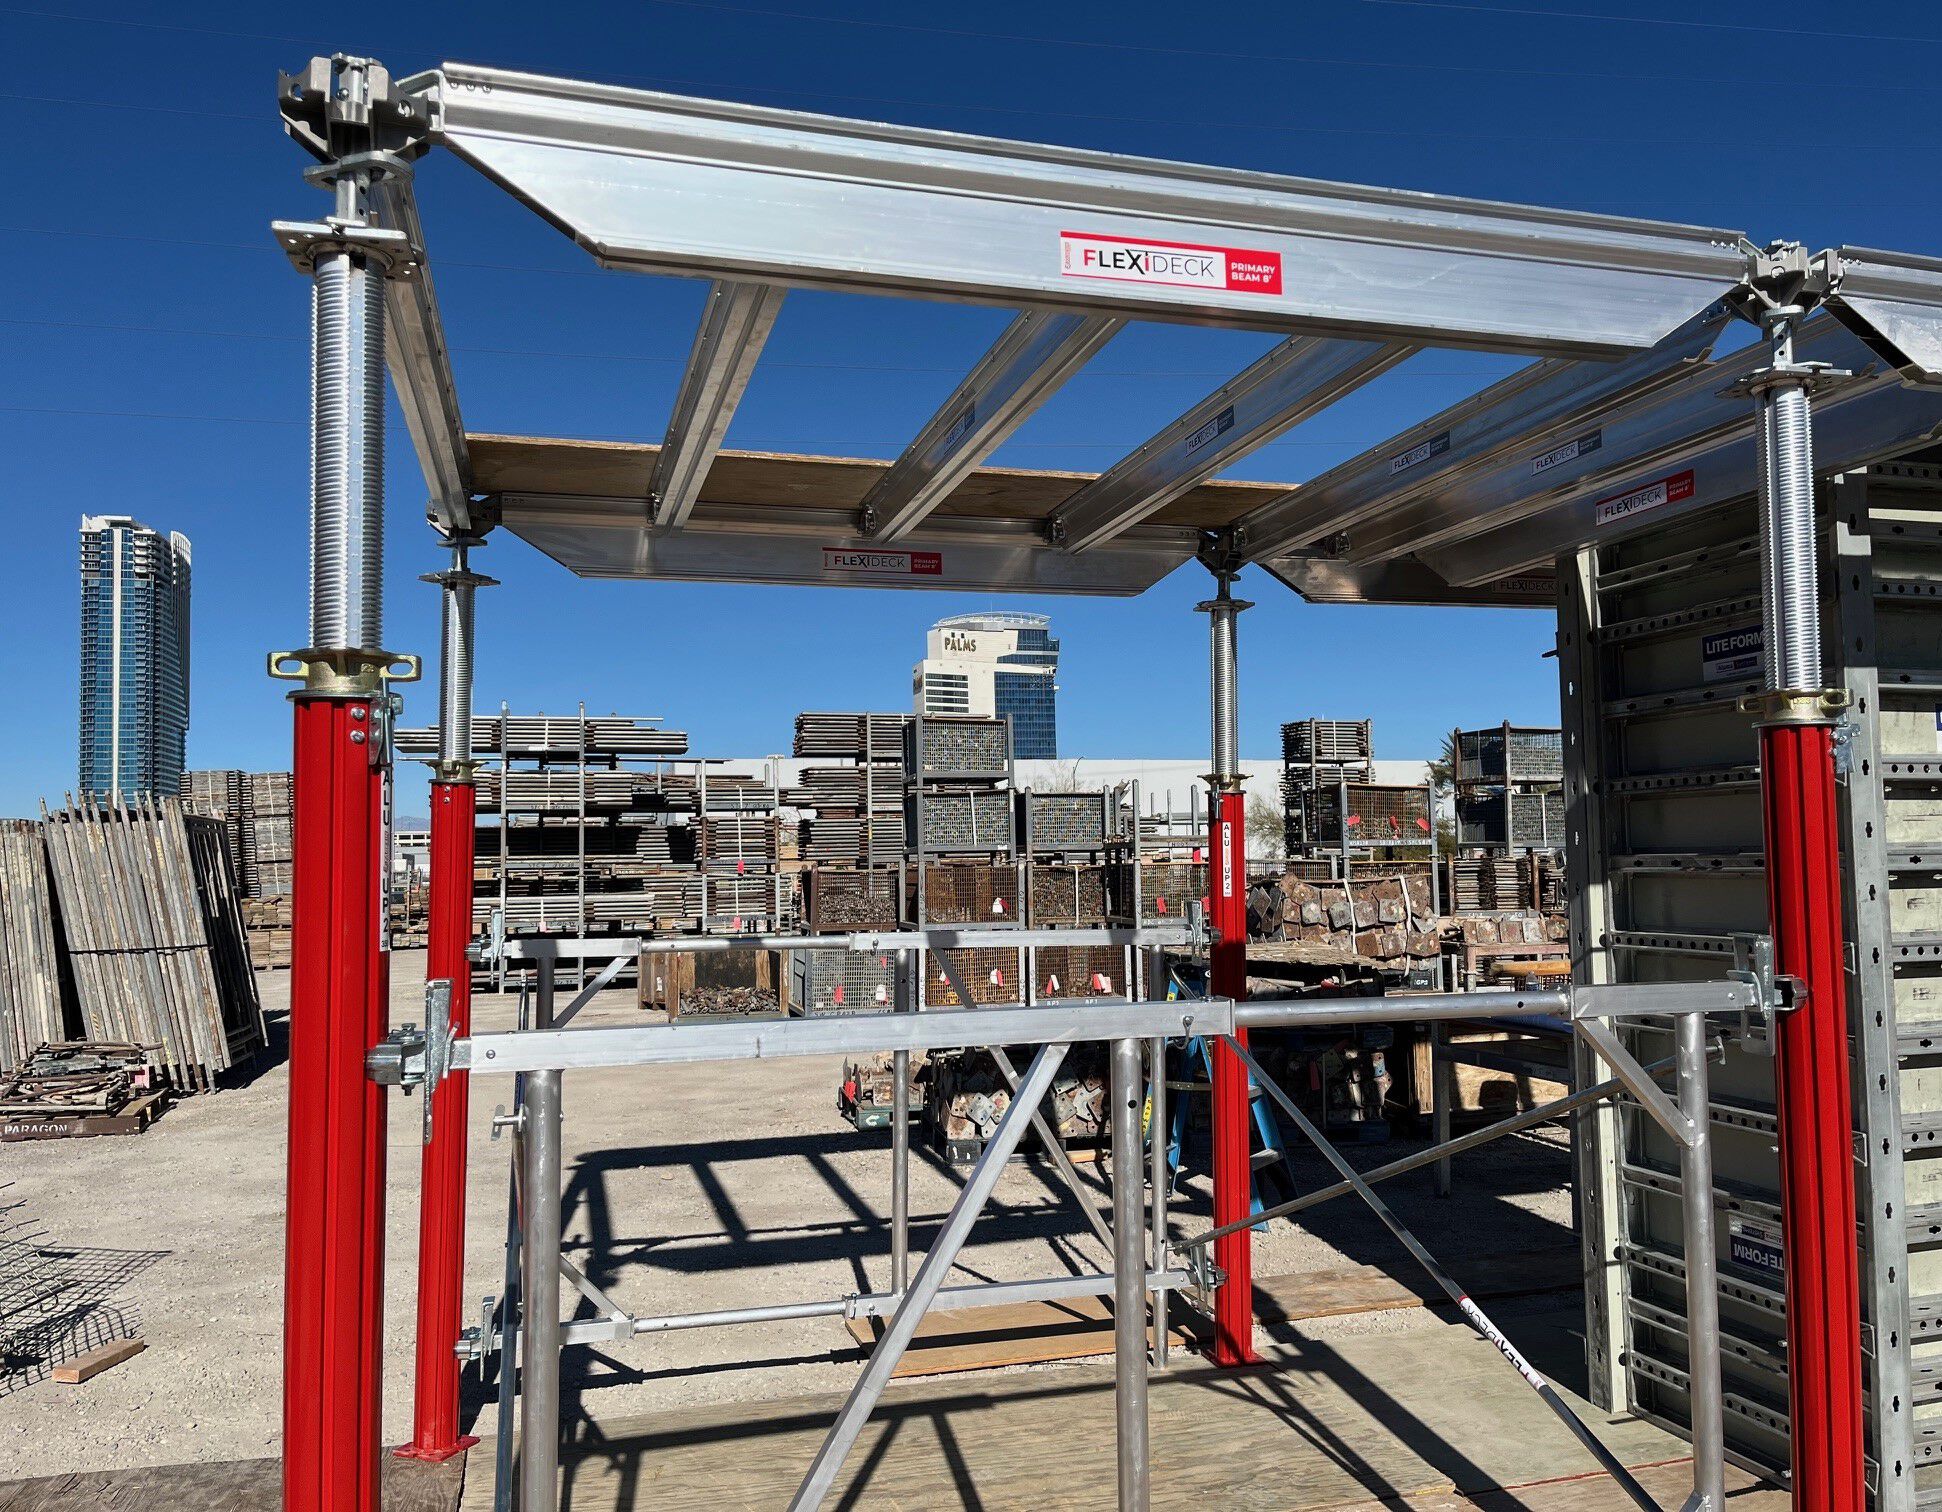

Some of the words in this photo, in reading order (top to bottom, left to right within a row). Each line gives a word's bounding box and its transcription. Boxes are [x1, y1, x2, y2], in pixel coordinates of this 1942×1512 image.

[1231, 262, 1275, 274] PRIMARY
[1231, 272, 1260, 282] BEAM
[944, 638, 976, 652] PALMS
[4, 1124, 68, 1135] PARAGON
